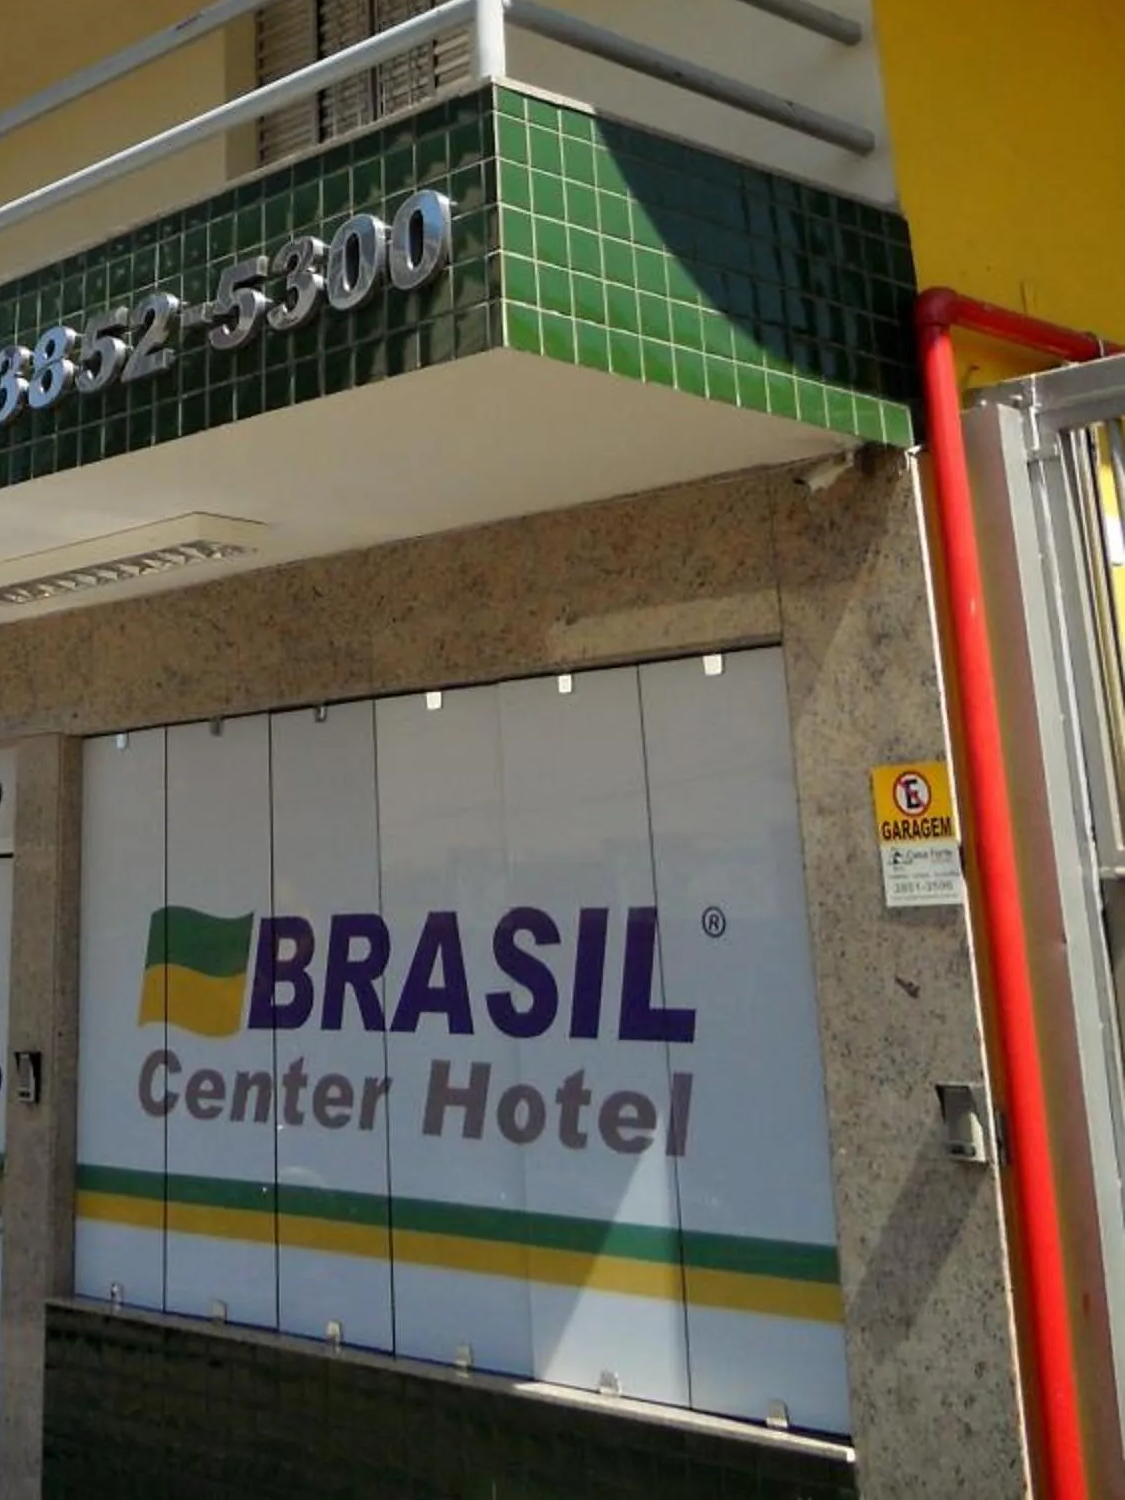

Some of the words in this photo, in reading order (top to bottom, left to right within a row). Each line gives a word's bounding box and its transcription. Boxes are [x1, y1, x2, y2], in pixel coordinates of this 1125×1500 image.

[881, 816, 953, 842] GARAGEM
[247, 905, 696, 1043] BRASIL
[137, 1049, 392, 1130] Center
[421, 1059, 694, 1157] Hotel
